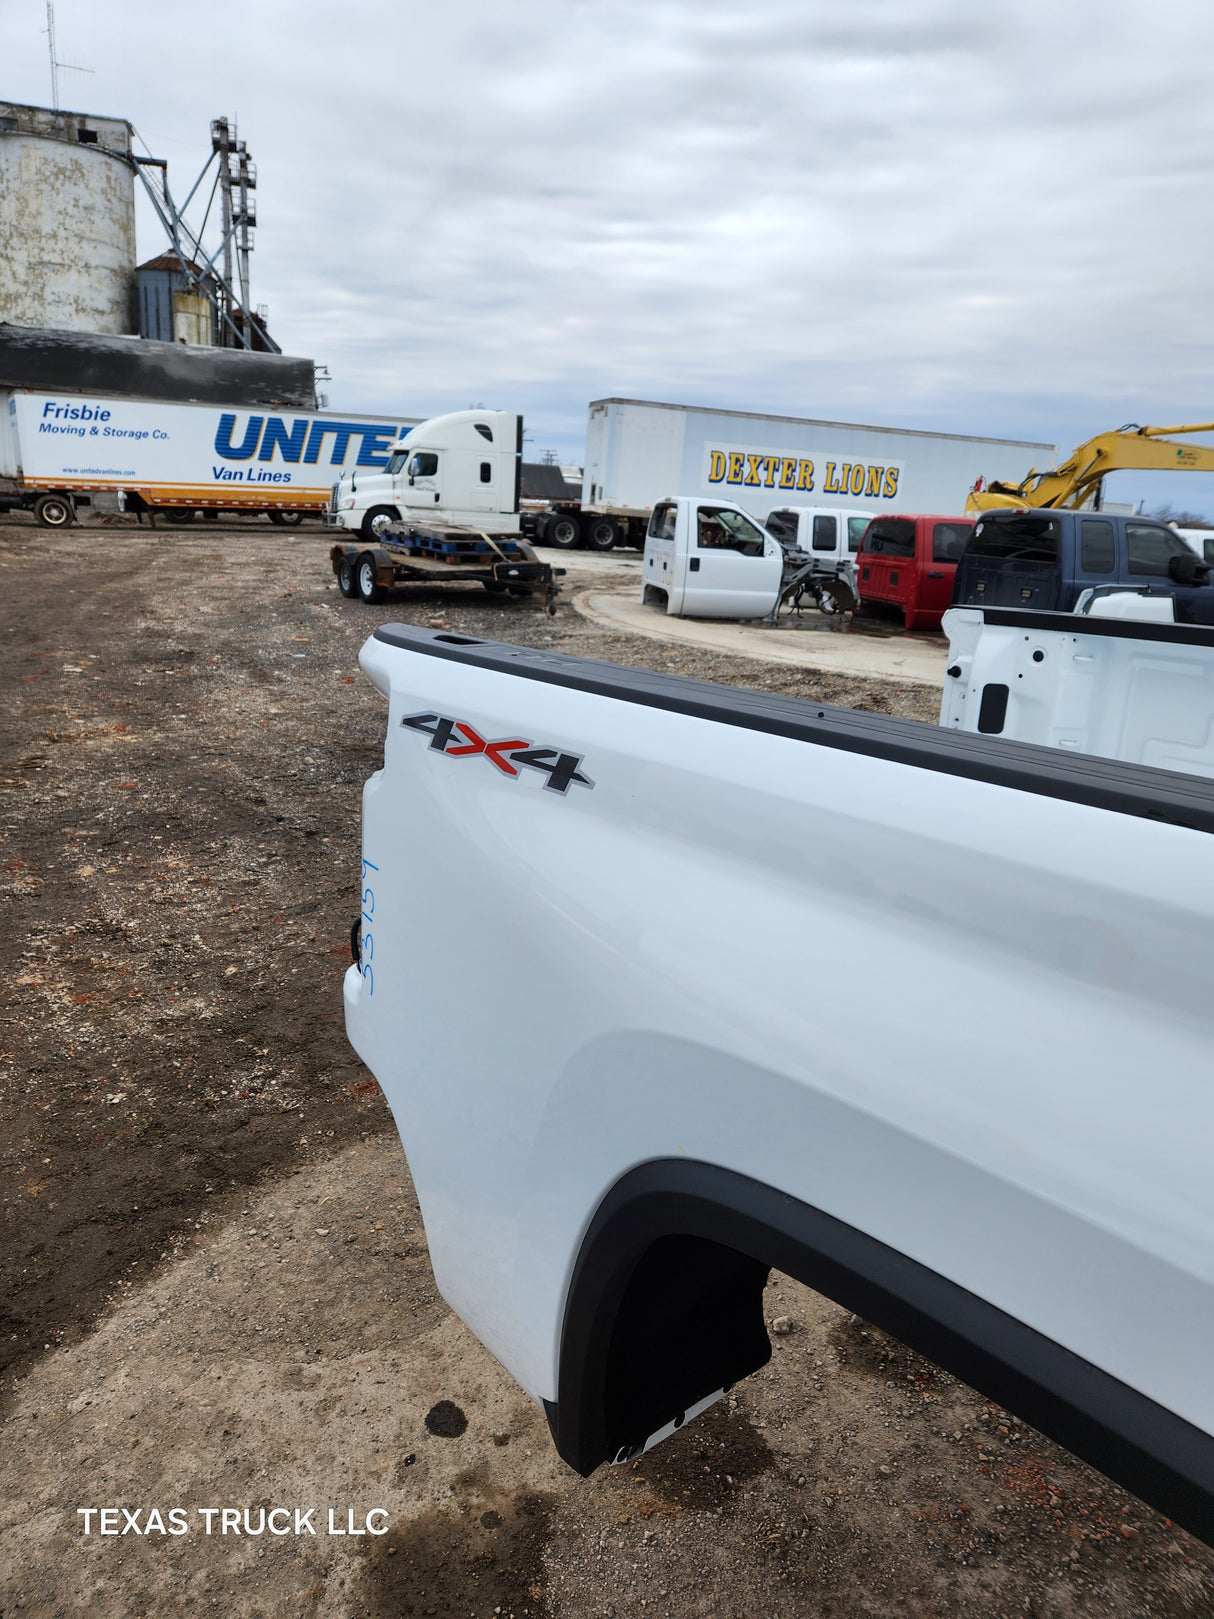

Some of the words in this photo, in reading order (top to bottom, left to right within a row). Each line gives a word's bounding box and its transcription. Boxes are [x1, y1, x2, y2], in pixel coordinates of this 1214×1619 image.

[42, 402, 112, 422] Frisbie
[38, 423, 86, 438] Moving
[89, 426, 99, 436] &
[102, 426, 149, 440] Storage
[152, 429, 171, 440] Co.
[214, 413, 415, 468] UNITE
[212, 466, 243, 481] Van
[246, 468, 292, 483] Lines
[708, 450, 815, 492] DEXTER
[823, 461, 900, 499] LIONS
